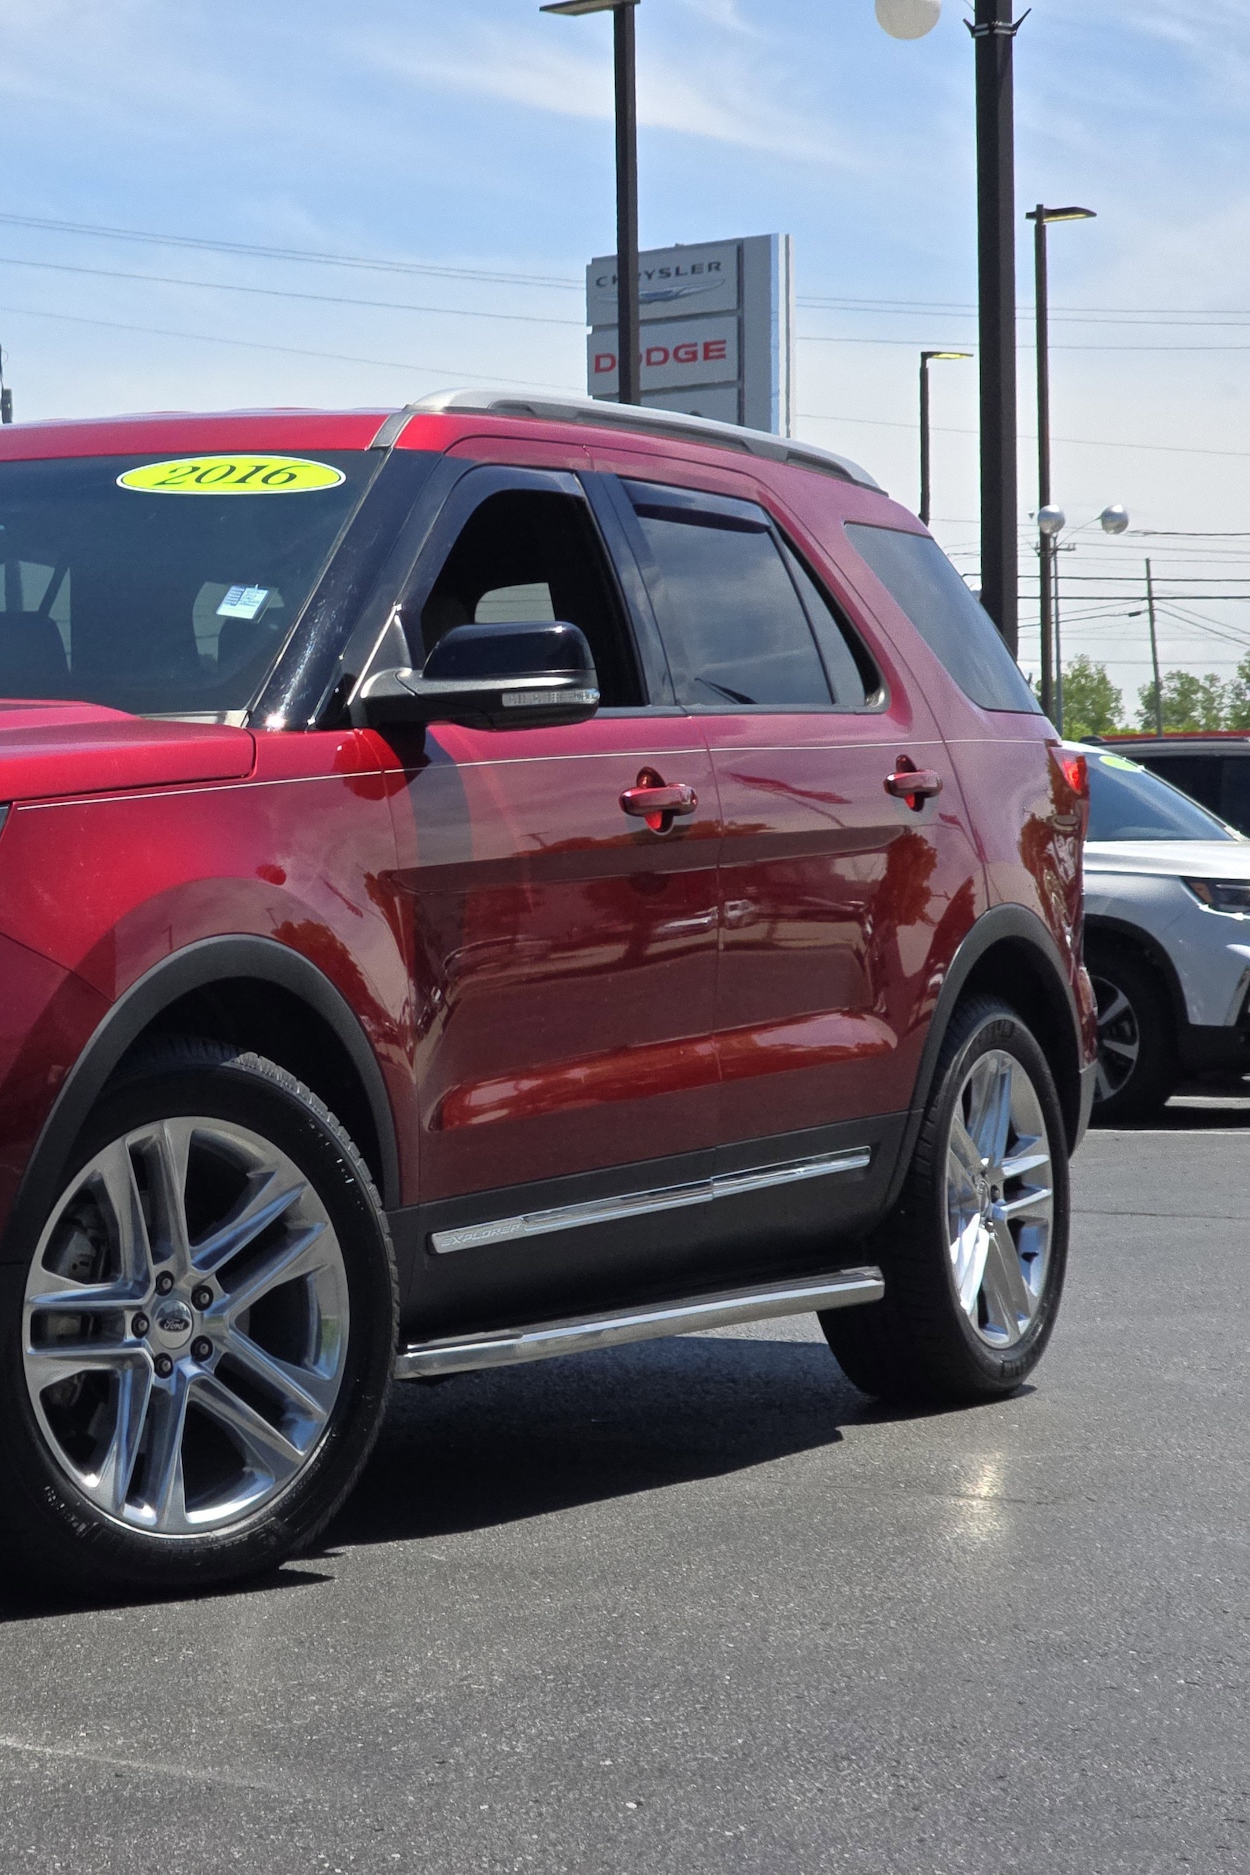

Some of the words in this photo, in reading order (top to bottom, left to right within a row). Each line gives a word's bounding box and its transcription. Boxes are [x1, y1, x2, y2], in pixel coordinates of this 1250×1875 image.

[595, 261, 722, 288] CYSLER
[594, 339, 727, 374] DDGE
[152, 464, 310, 487] 2016
[441, 1224, 520, 1247] EXPLORER
[163, 1318, 185, 1330] Ford
